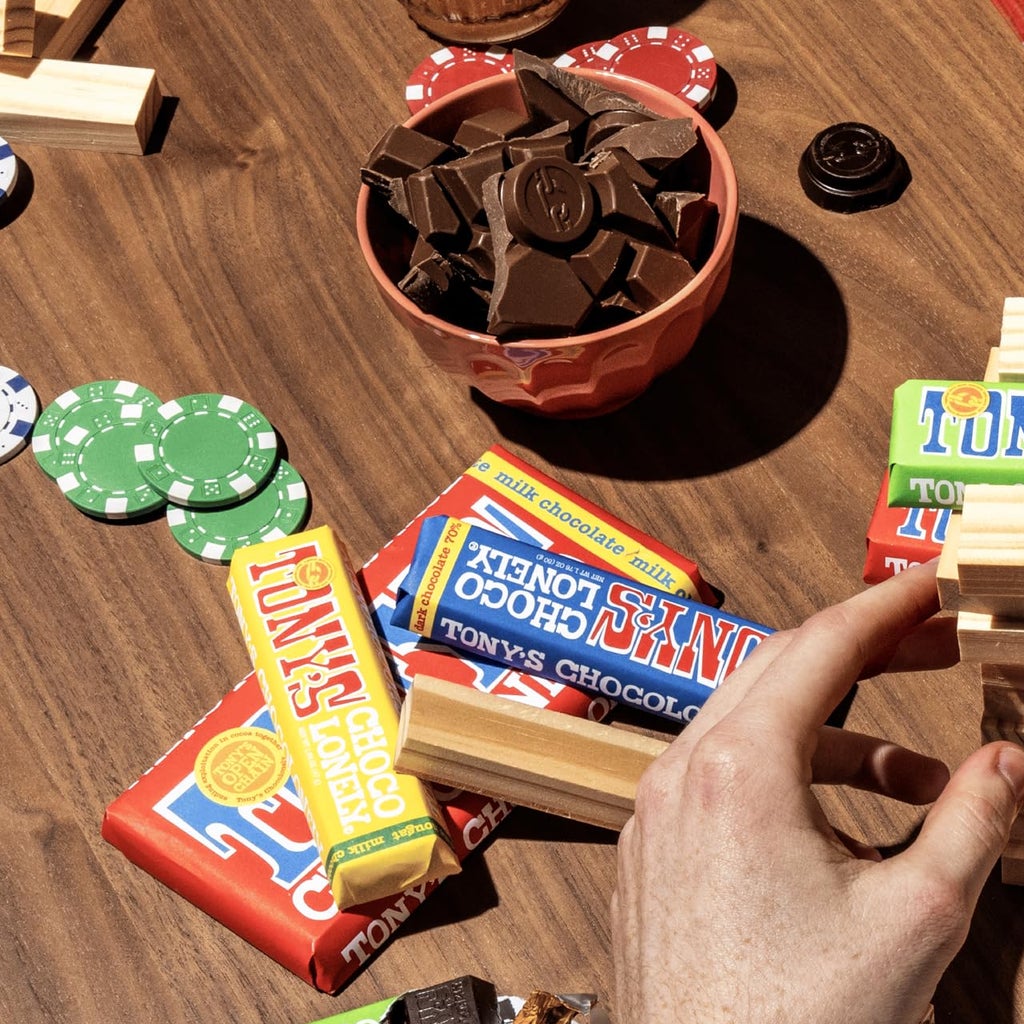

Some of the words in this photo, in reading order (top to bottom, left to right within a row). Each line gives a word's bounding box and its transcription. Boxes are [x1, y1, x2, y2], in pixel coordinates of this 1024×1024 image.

[494, 471, 540, 503] milk
[538, 498, 625, 556] chocolate
[628, 553, 677, 590] milk
[413, 607, 428, 632] dark
[421, 546, 451, 607] chocolate
[444, 522, 462, 544] 70%
[453, 571, 588, 640] CHOCO
[246, 540, 373, 723] TONY'S
[440, 617, 546, 673] TONY'S
[587, 582, 774, 689] ONY'S
[221, 749, 264, 787] OPEN
[232, 757, 275, 793] CHAIN
[344, 706, 407, 820] CHOCO
[347, 836, 385, 856] milk
[390, 821, 436, 842] ougat
